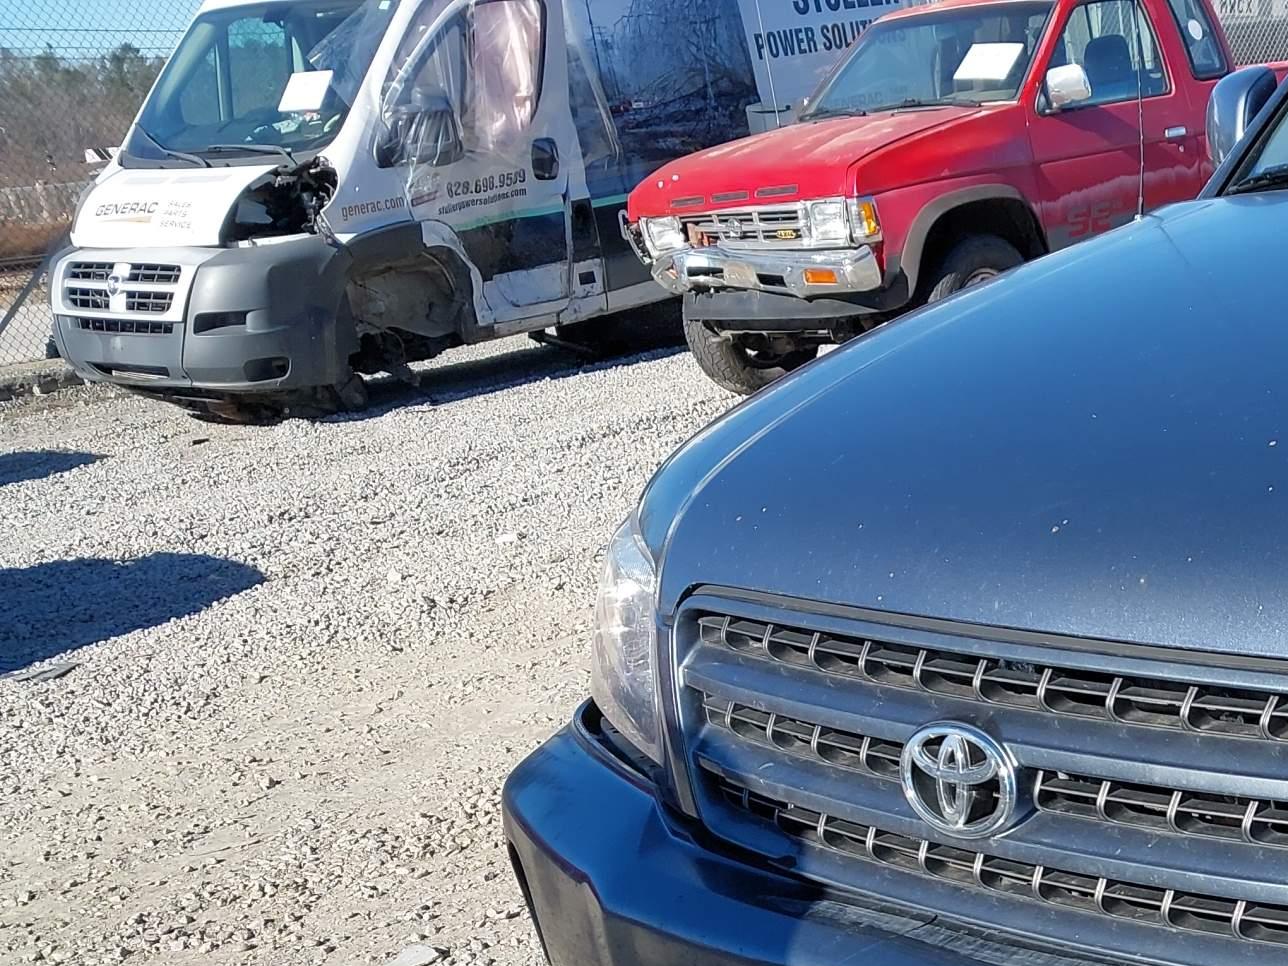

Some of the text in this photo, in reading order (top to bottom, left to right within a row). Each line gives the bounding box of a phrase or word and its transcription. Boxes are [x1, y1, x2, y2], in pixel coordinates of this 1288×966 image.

[754, 26, 818, 60] POWER
[95, 201, 159, 217] GENERAC
[341, 196, 405, 221] generac.com
